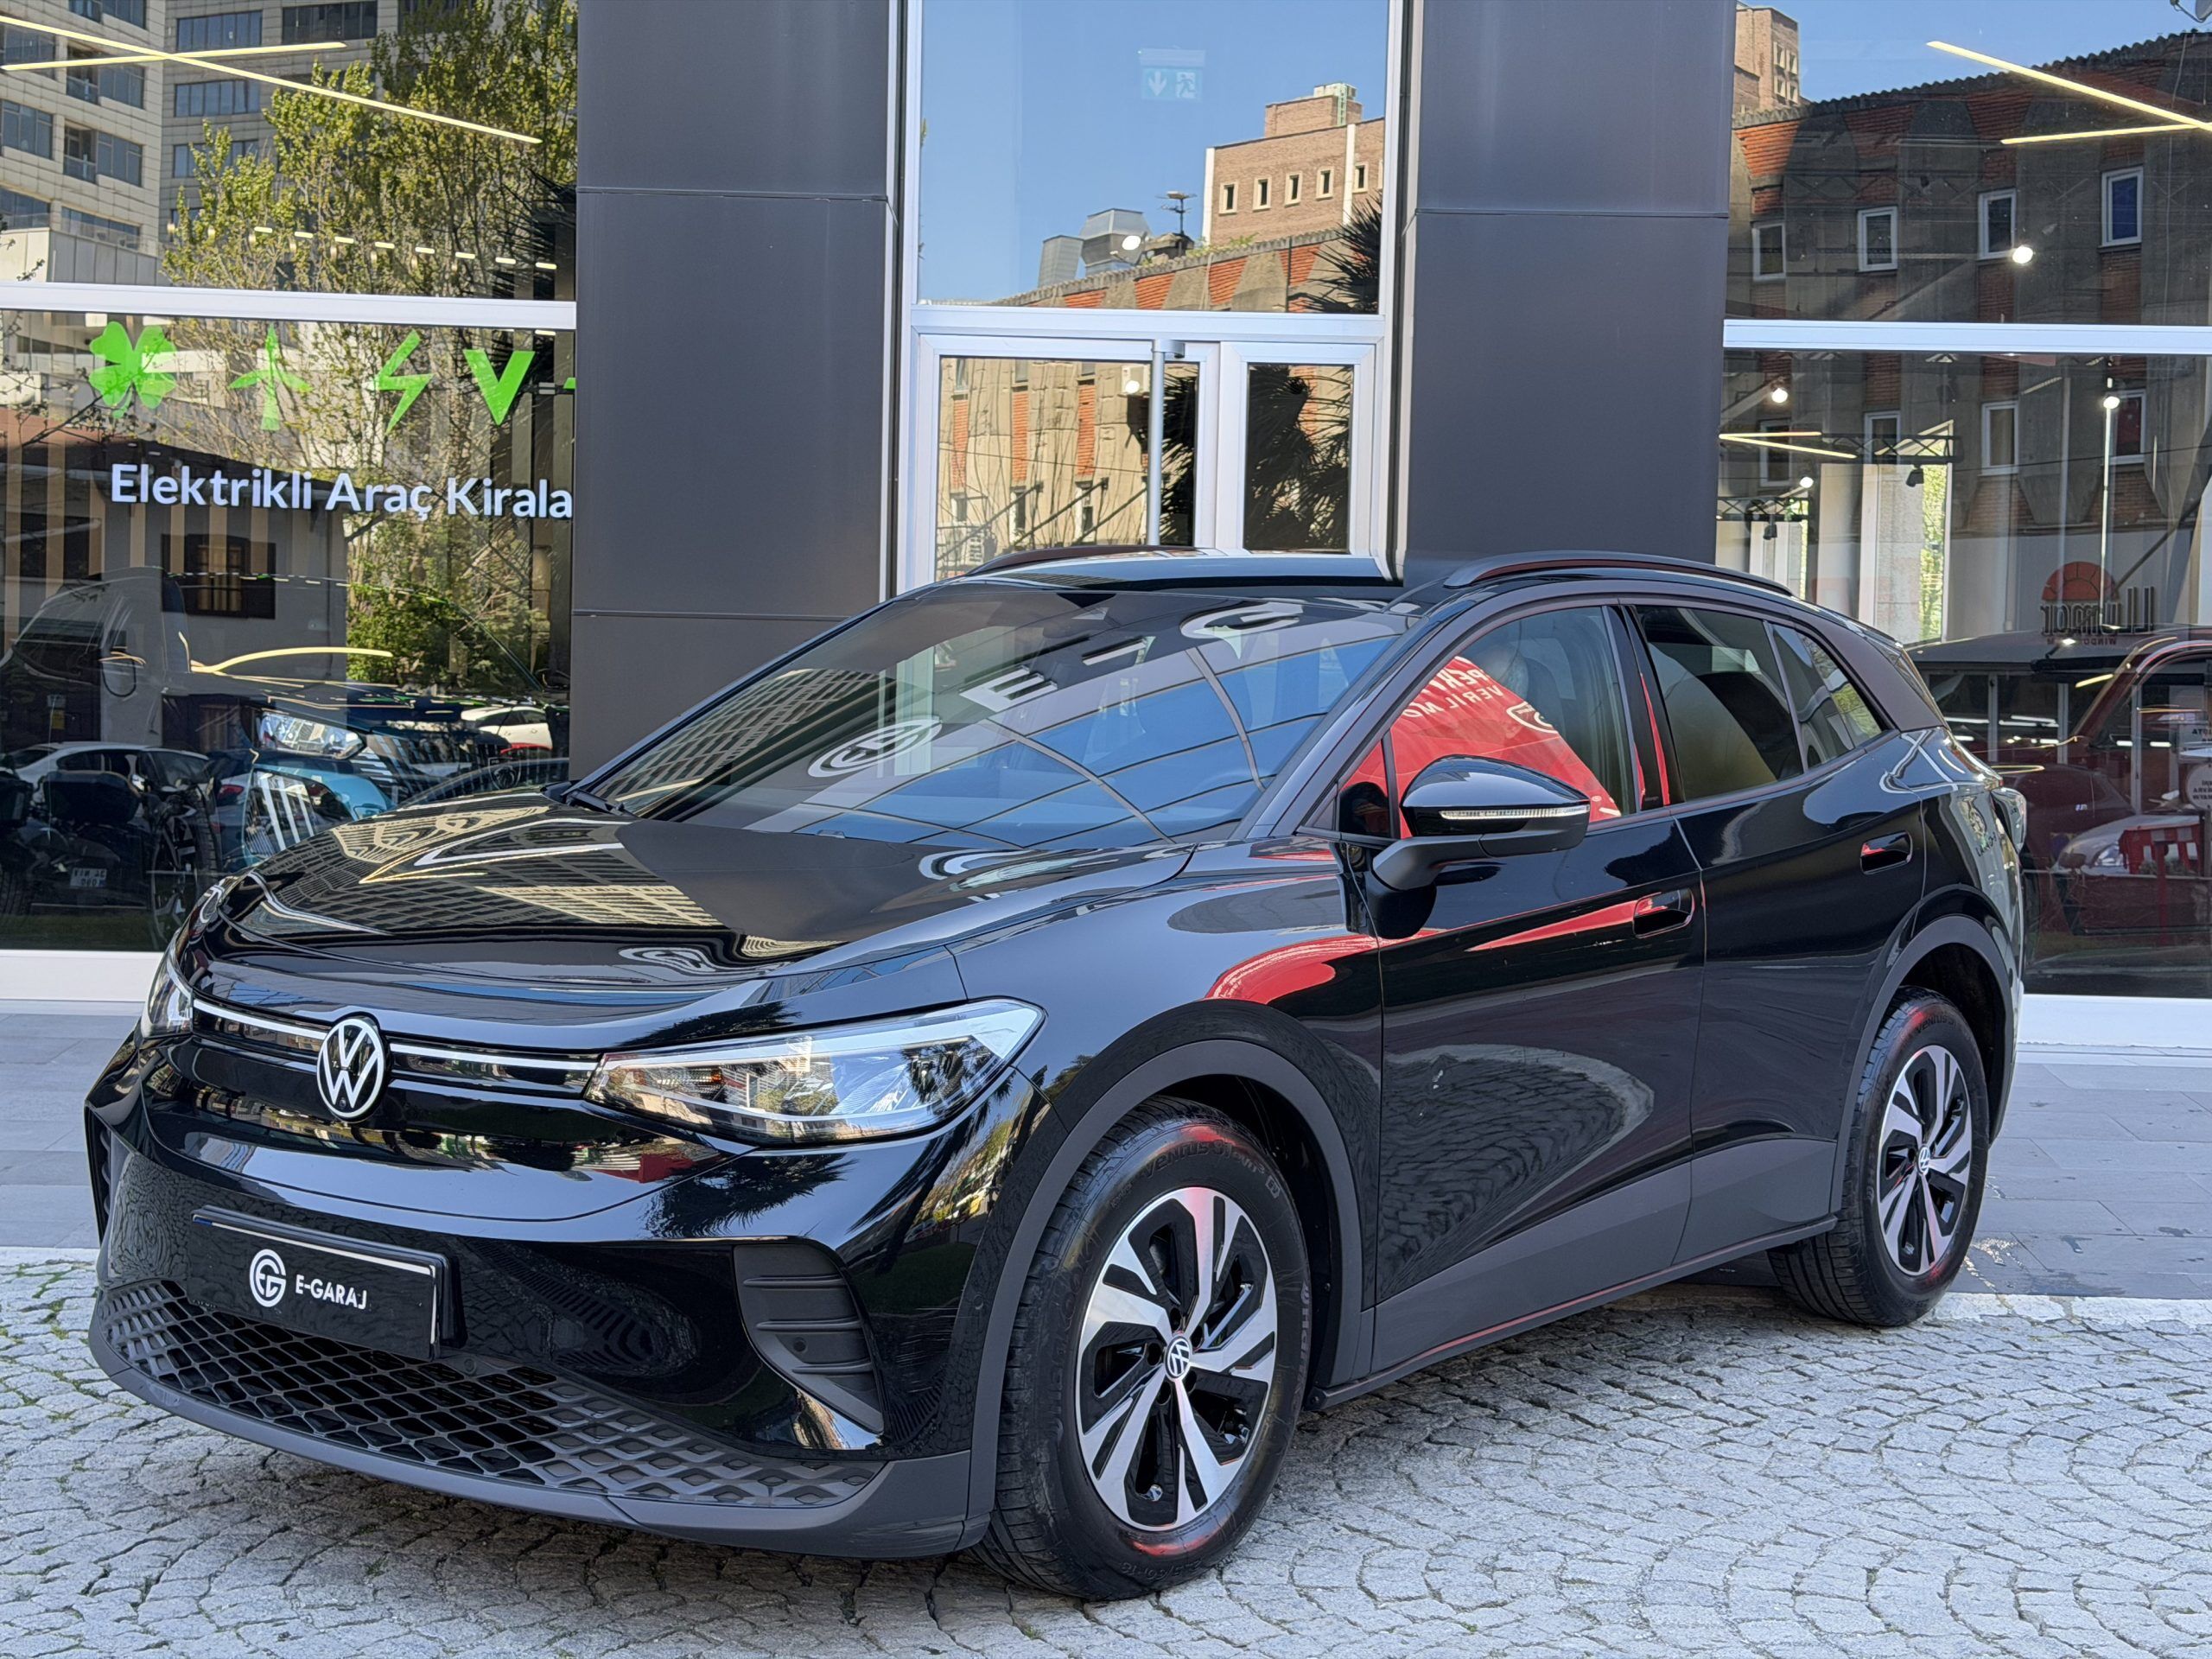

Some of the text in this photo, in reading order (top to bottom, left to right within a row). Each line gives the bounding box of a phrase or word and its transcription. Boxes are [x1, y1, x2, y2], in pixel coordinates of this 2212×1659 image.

[111, 464, 573, 521] Elektrikli Araç Kirala
[295, 1274, 368, 1310] E-GARAJ
